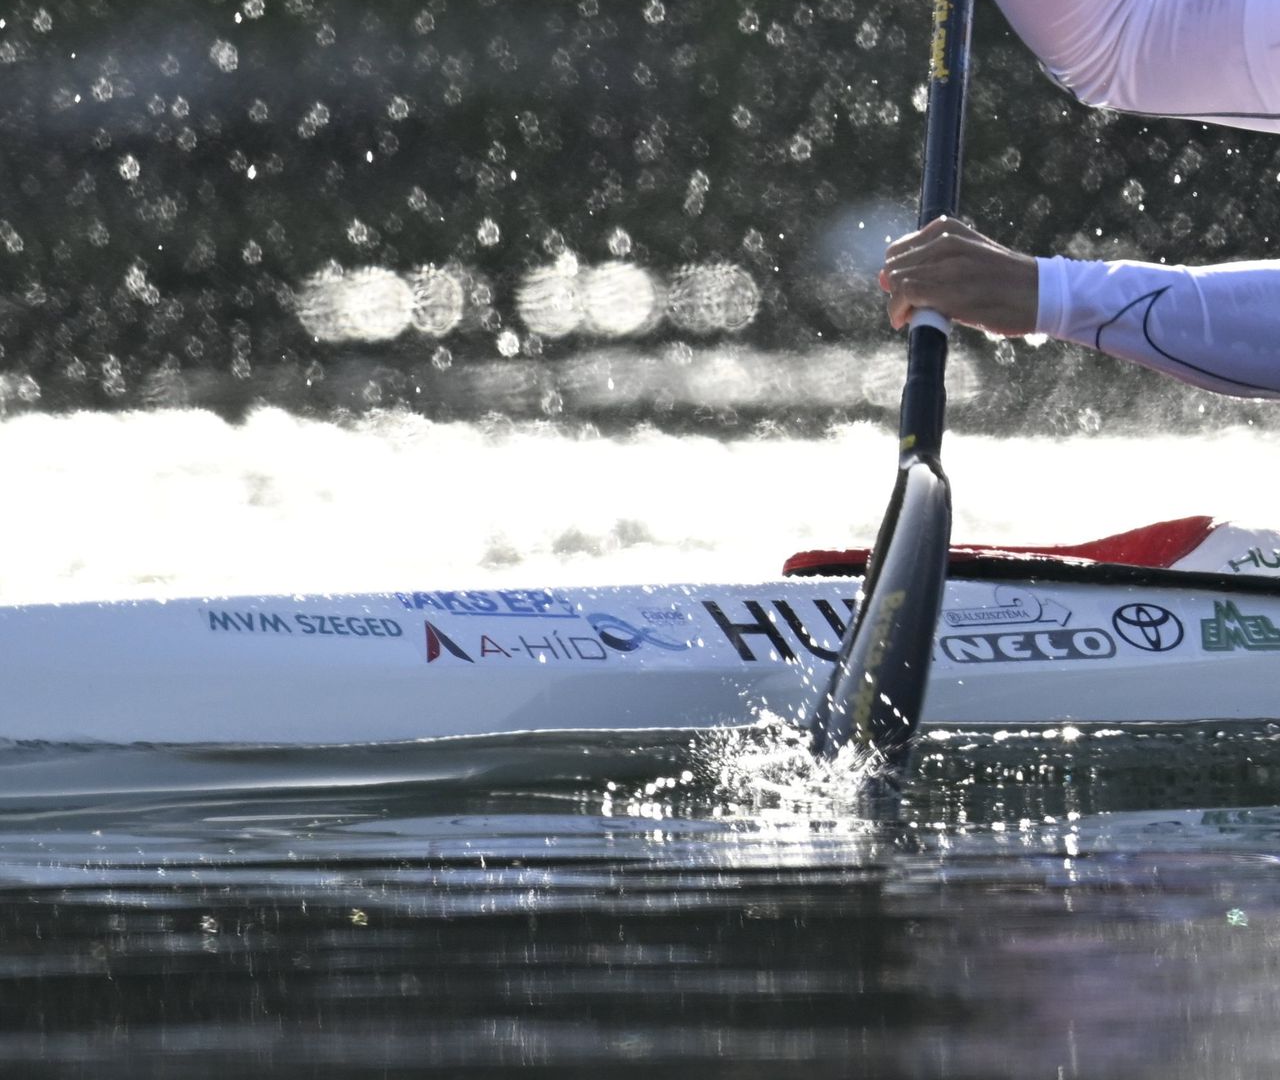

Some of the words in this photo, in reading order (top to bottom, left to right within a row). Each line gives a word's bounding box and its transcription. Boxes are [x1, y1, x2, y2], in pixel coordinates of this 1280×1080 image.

[208, 610, 292, 634] MVM
[294, 613, 403, 638] SZEGED
[701, 599, 862, 662] HU
[480, 630, 608, 661] A-HÍD
[946, 630, 1102, 661] NELO
